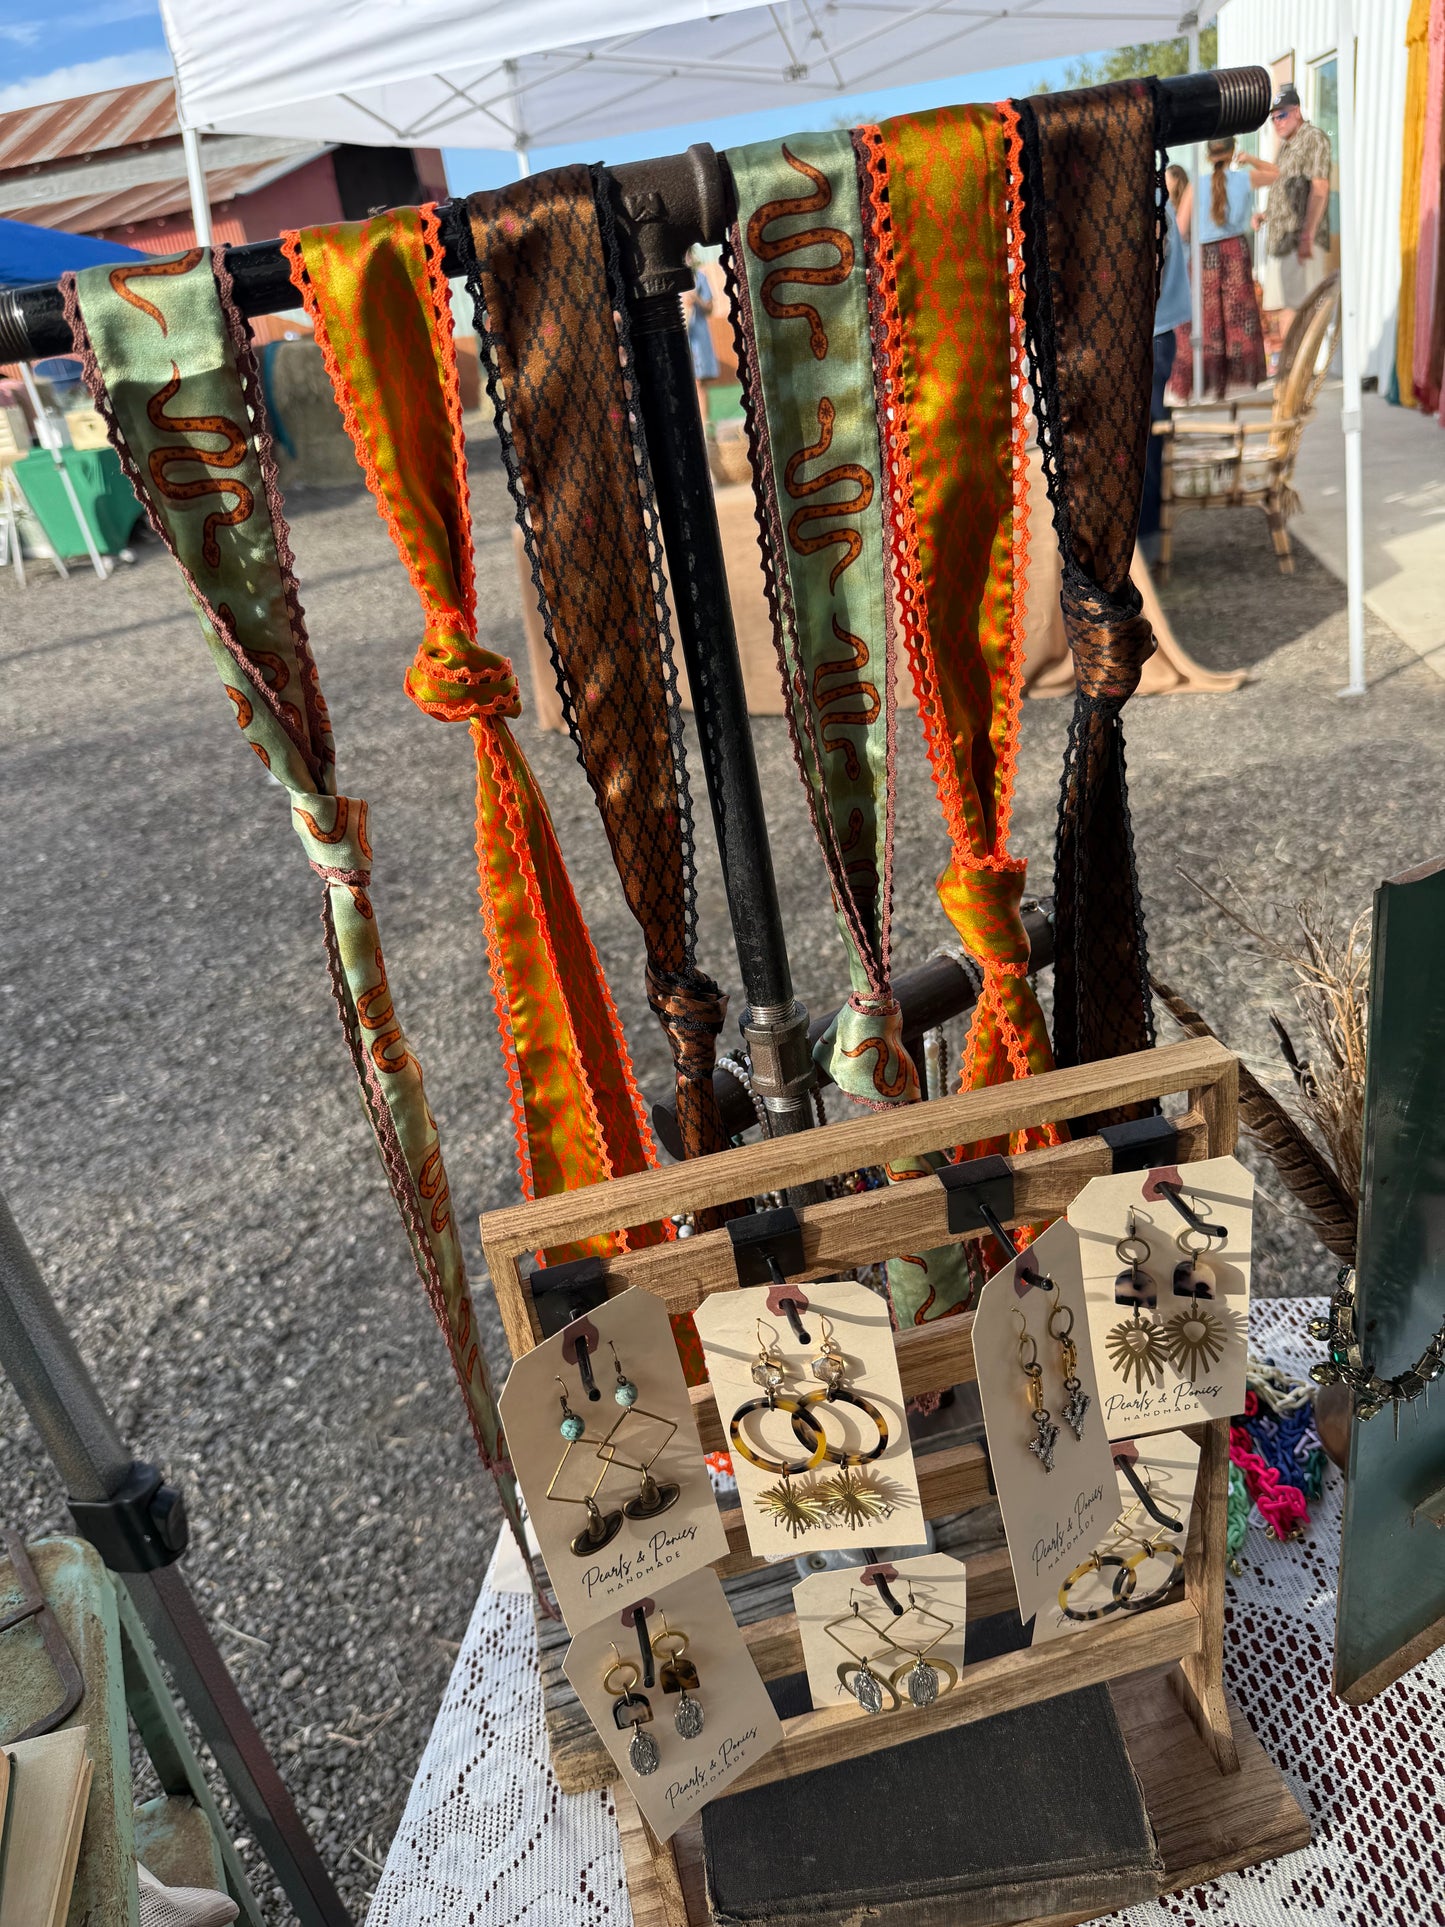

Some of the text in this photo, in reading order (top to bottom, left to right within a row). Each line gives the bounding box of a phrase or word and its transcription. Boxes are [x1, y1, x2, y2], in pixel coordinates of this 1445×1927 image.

[1104, 1381, 1223, 1420] Pearls & Ponies
[1124, 1402, 1199, 1422] HANDMADE
[1032, 1484, 1103, 1577] Pearls & Ponies
[1048, 1514, 1094, 1570] HANDMADE
[581, 1526, 698, 1598] Pearls & Ponies
[607, 1551, 681, 1594] HANDMADE
[665, 1726, 758, 1809] Pearls & Ponies
[687, 1750, 745, 1800] HANDMADE
